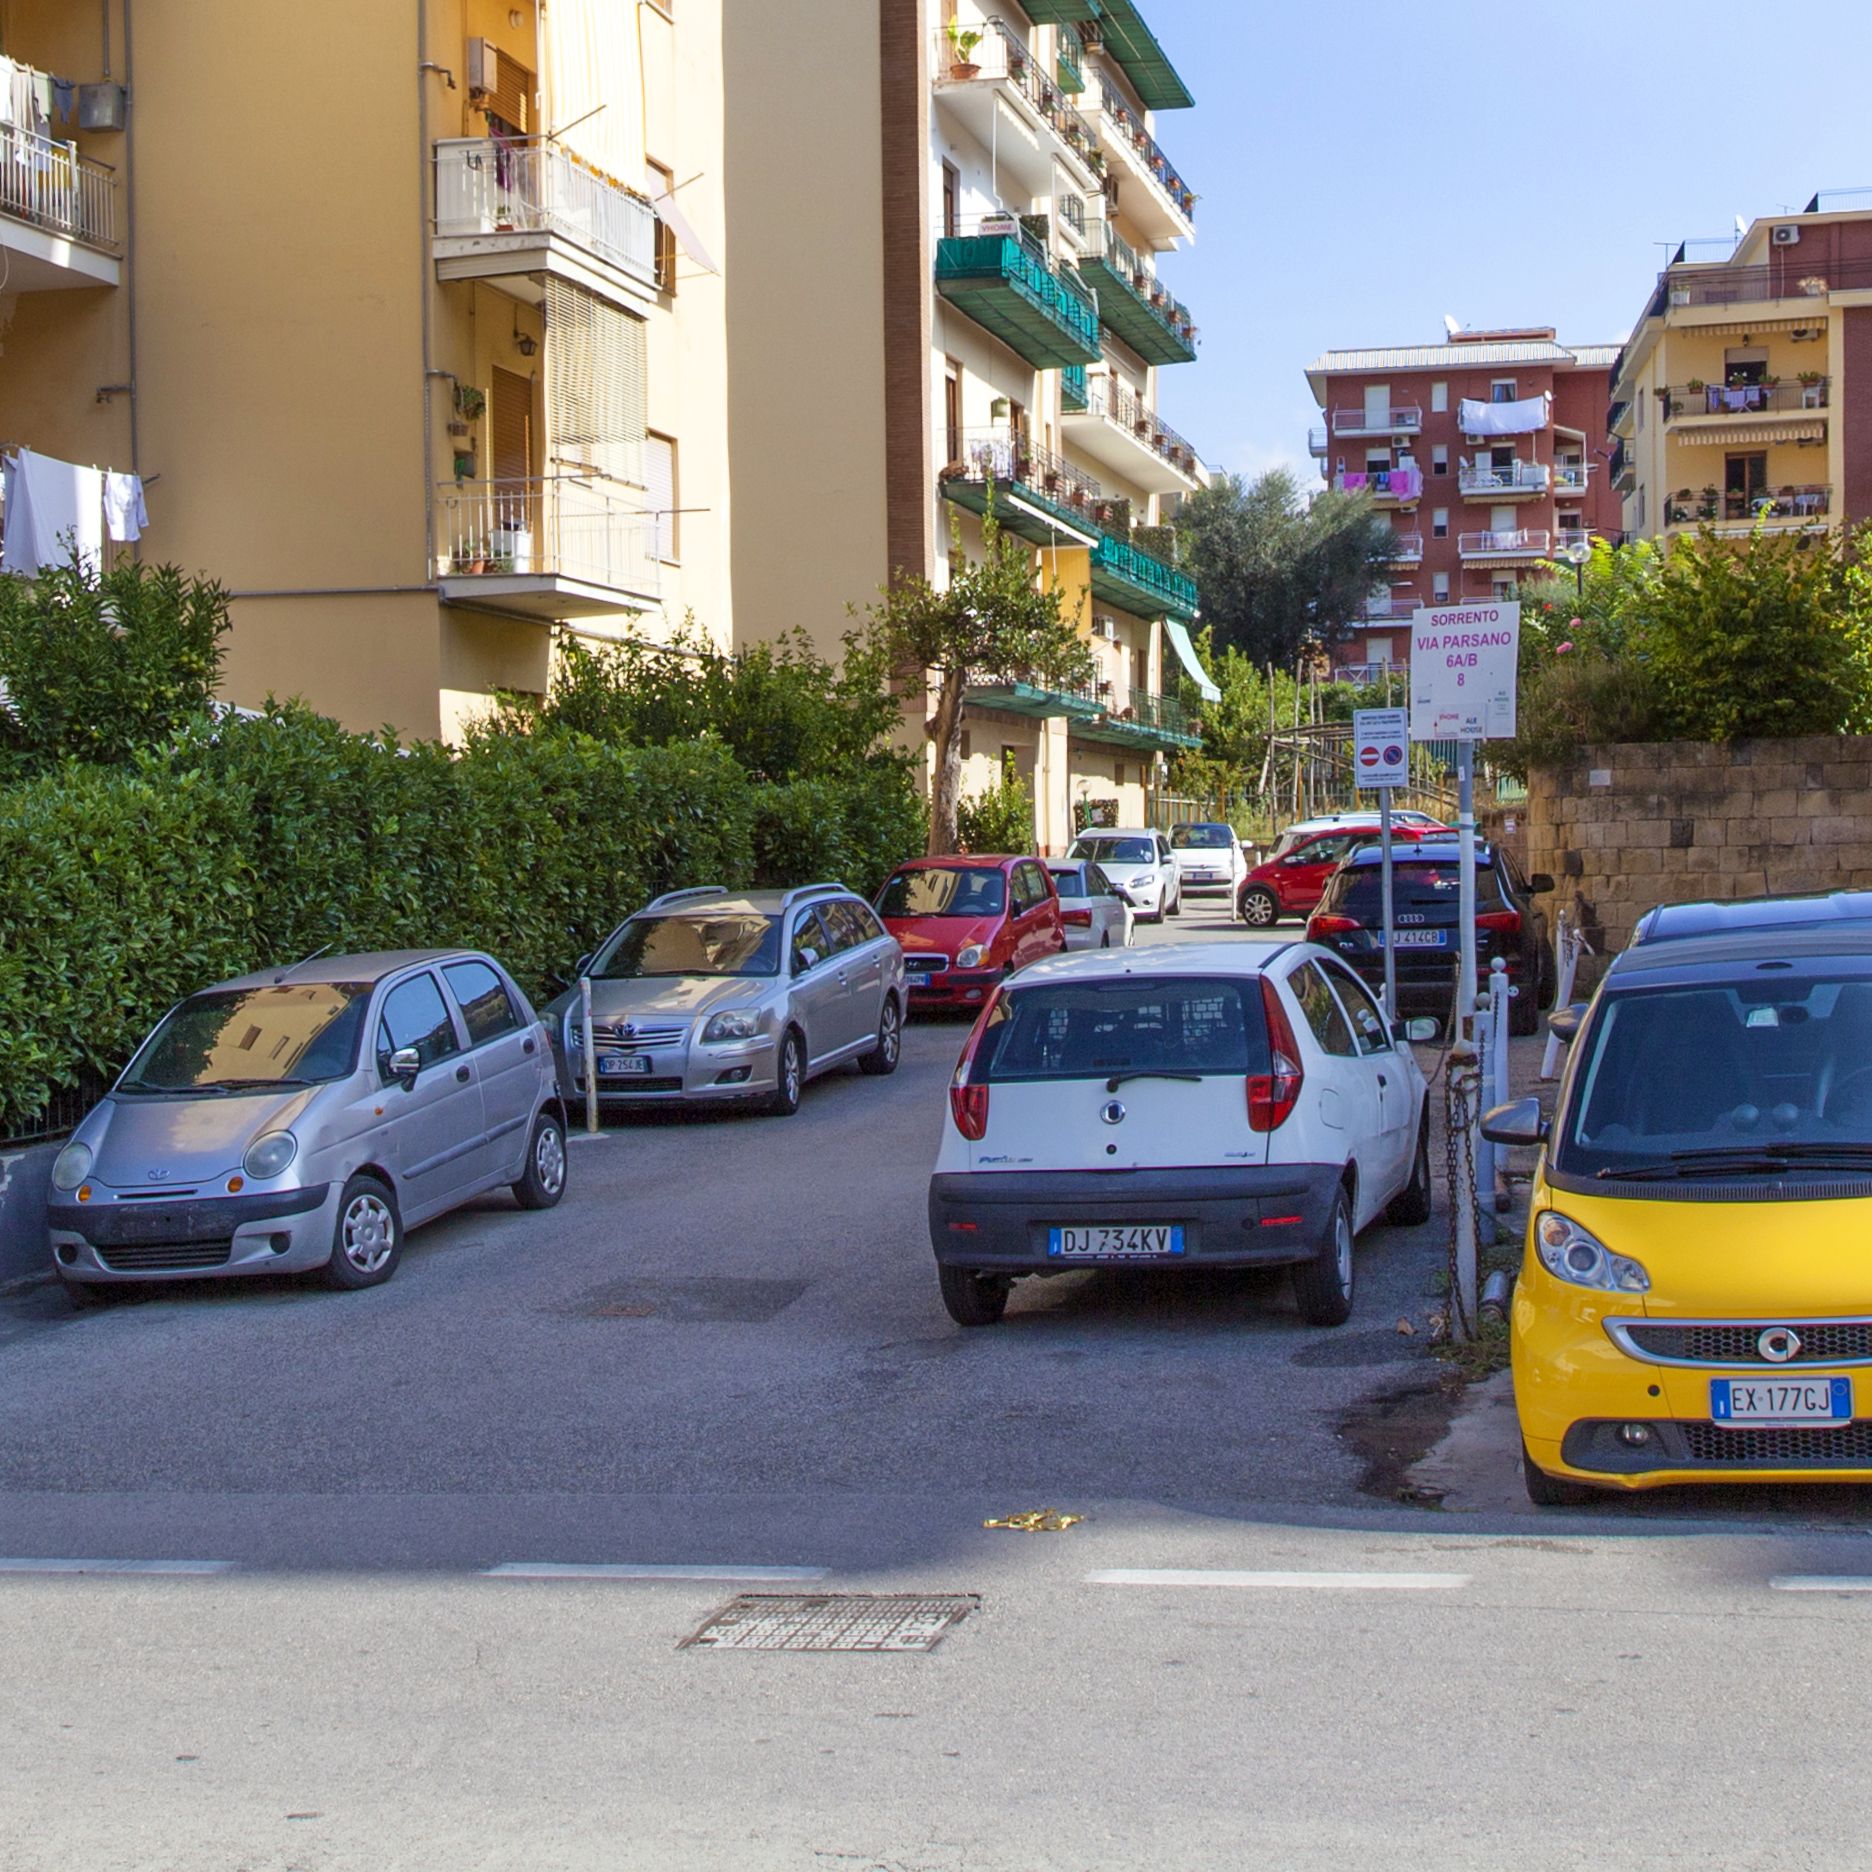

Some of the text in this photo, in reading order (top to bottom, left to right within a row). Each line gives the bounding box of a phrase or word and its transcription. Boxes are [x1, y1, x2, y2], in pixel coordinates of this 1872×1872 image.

[1430, 609, 1499, 627] SORRENTO
[1417, 631, 1512, 651] VIA PARSANO
[1446, 652, 1478, 668] 6A/B
[1456, 672, 1465, 687] 8
